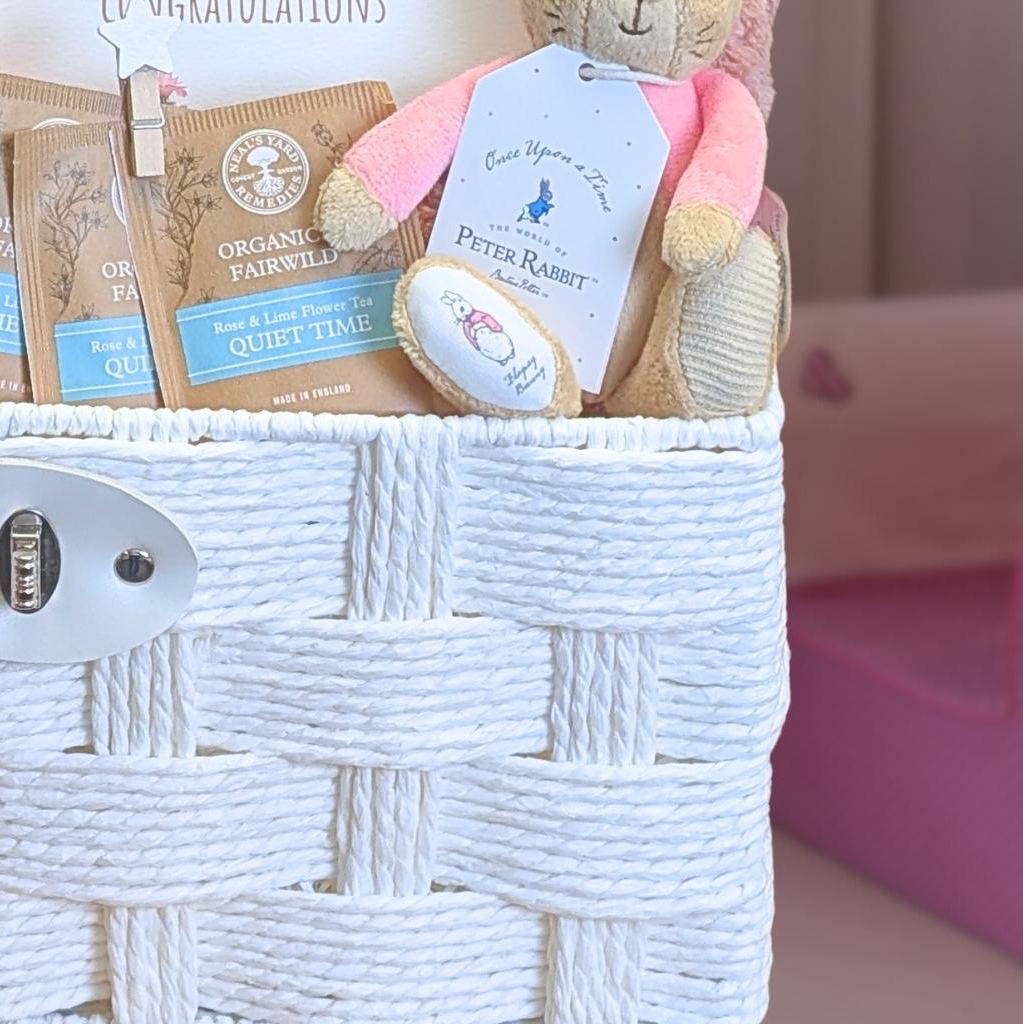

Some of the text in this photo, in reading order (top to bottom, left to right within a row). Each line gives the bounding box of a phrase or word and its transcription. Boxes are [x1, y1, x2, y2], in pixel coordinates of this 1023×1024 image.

[229, 136, 299, 173] NEAL'S YARD
[235, 176, 302, 208] REMEDIES
[485, 139, 612, 213] Once Upon a Time
[218, 227, 321, 260] ORGANIC
[454, 225, 516, 265] PETER
[489, 224, 568, 257] THE WORLD OF
[229, 248, 338, 282] FAIRWILD
[213, 296, 374, 334] Rose & Lime Flower Tea
[90, 340, 122, 353] Rose
[126, 336, 137, 349] &
[229, 314, 373, 358] QUIET TIME
[9, 381, 18, 391] IN
[273, 383, 352, 406] MADE IN ENGLAND
